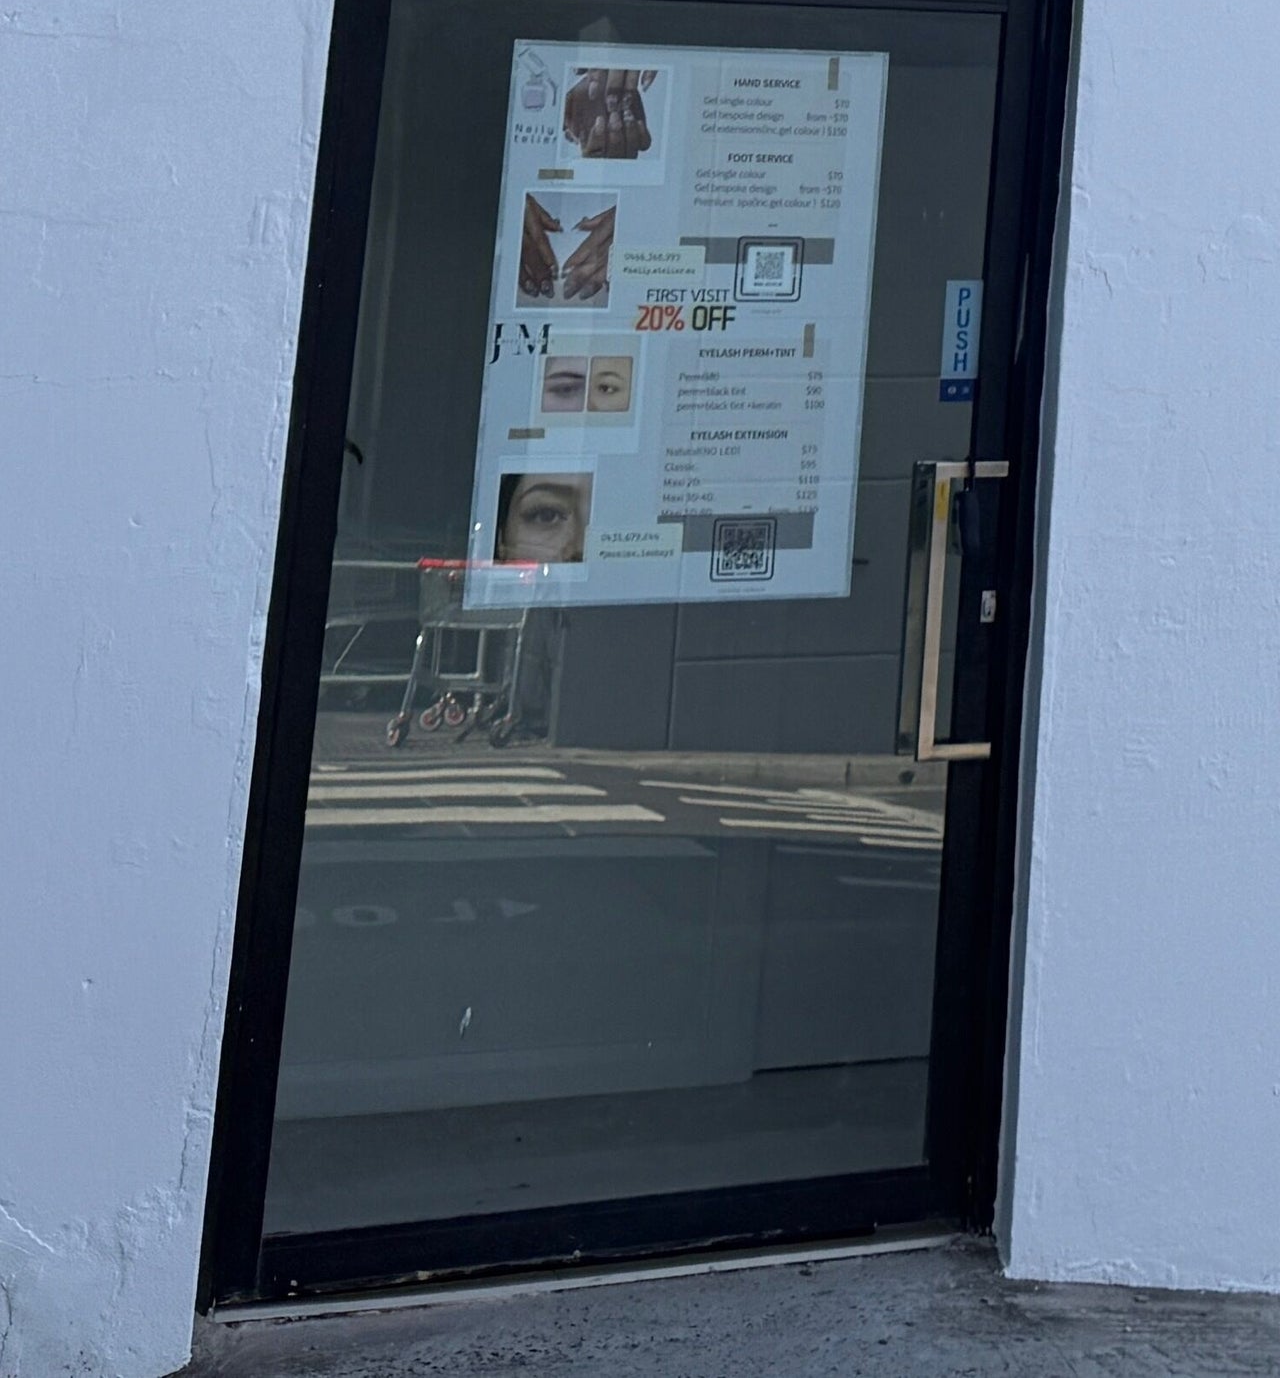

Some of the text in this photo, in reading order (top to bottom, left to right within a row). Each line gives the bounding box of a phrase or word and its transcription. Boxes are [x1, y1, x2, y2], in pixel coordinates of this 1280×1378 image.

[734, 78, 801, 89] HAND SERVICE
[728, 154, 794, 163] FOOT SERVICE
[647, 289, 730, 302] FIRST VISIT
[635, 305, 737, 331] 20% OFF
[953, 287, 971, 372] PUSH
[699, 348, 741, 358] EYELASH
[690, 430, 788, 440] EYELASH EXTENSION
